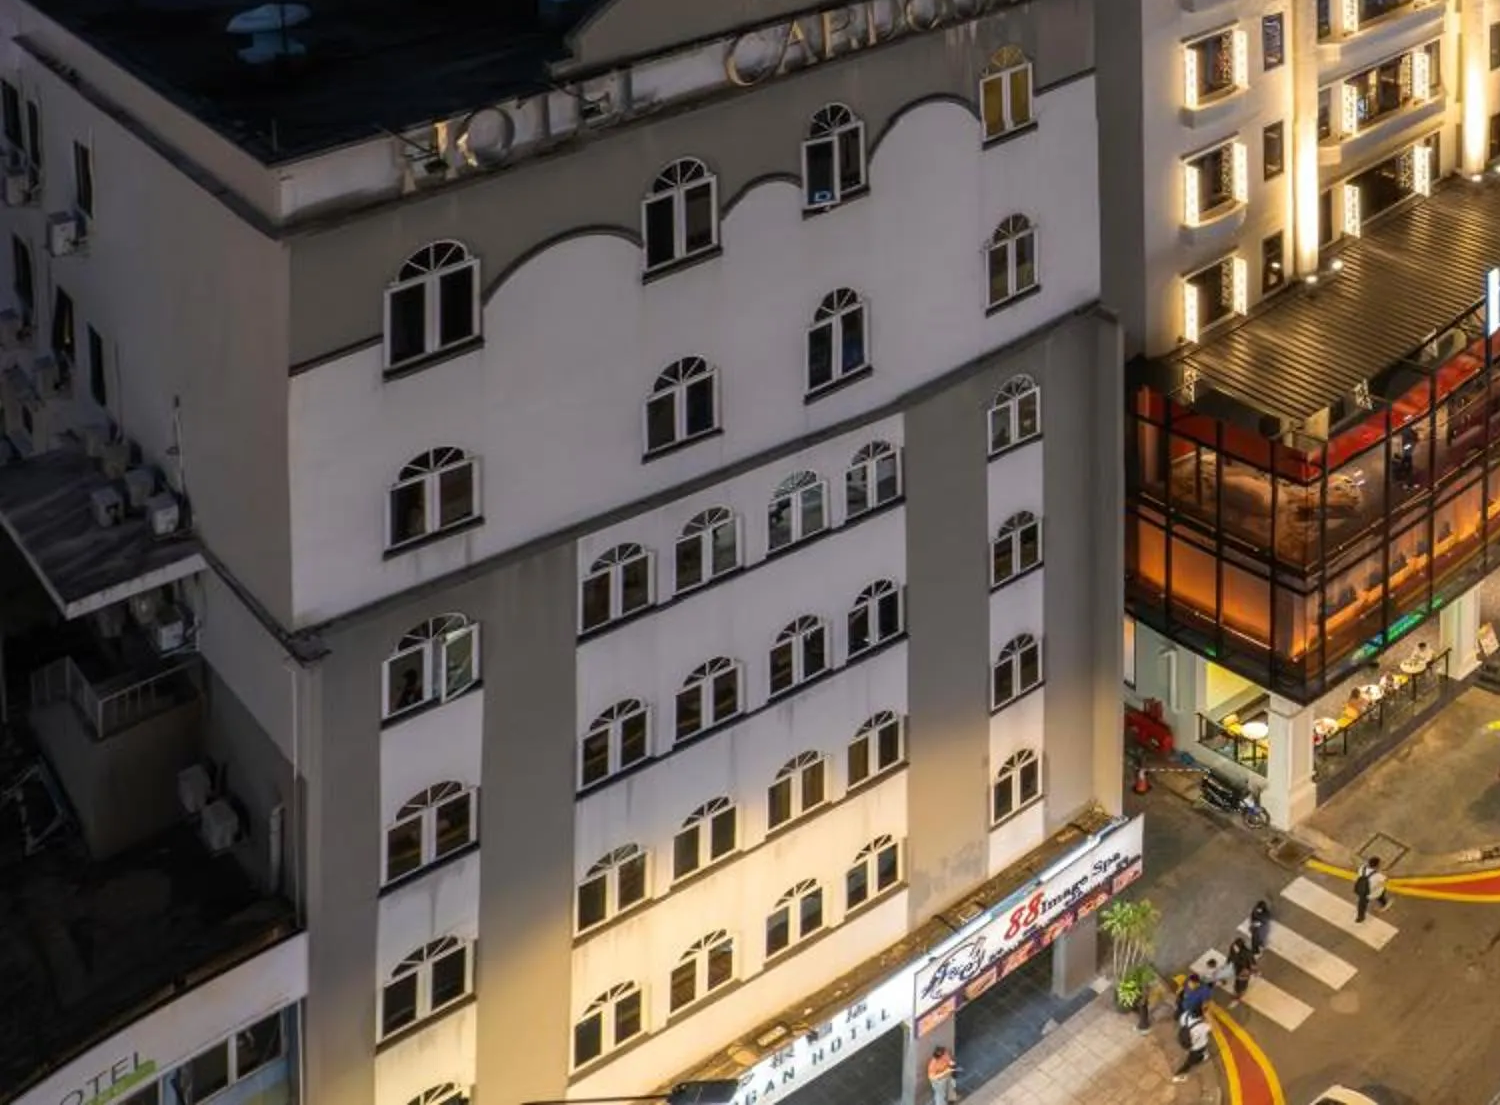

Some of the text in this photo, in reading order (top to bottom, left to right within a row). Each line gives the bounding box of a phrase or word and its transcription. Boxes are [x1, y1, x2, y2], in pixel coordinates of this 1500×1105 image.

[1003, 887, 1045, 940] 88
[812, 1008, 890, 1066] HOTEL
[59, 1050, 139, 1105] OTEL
